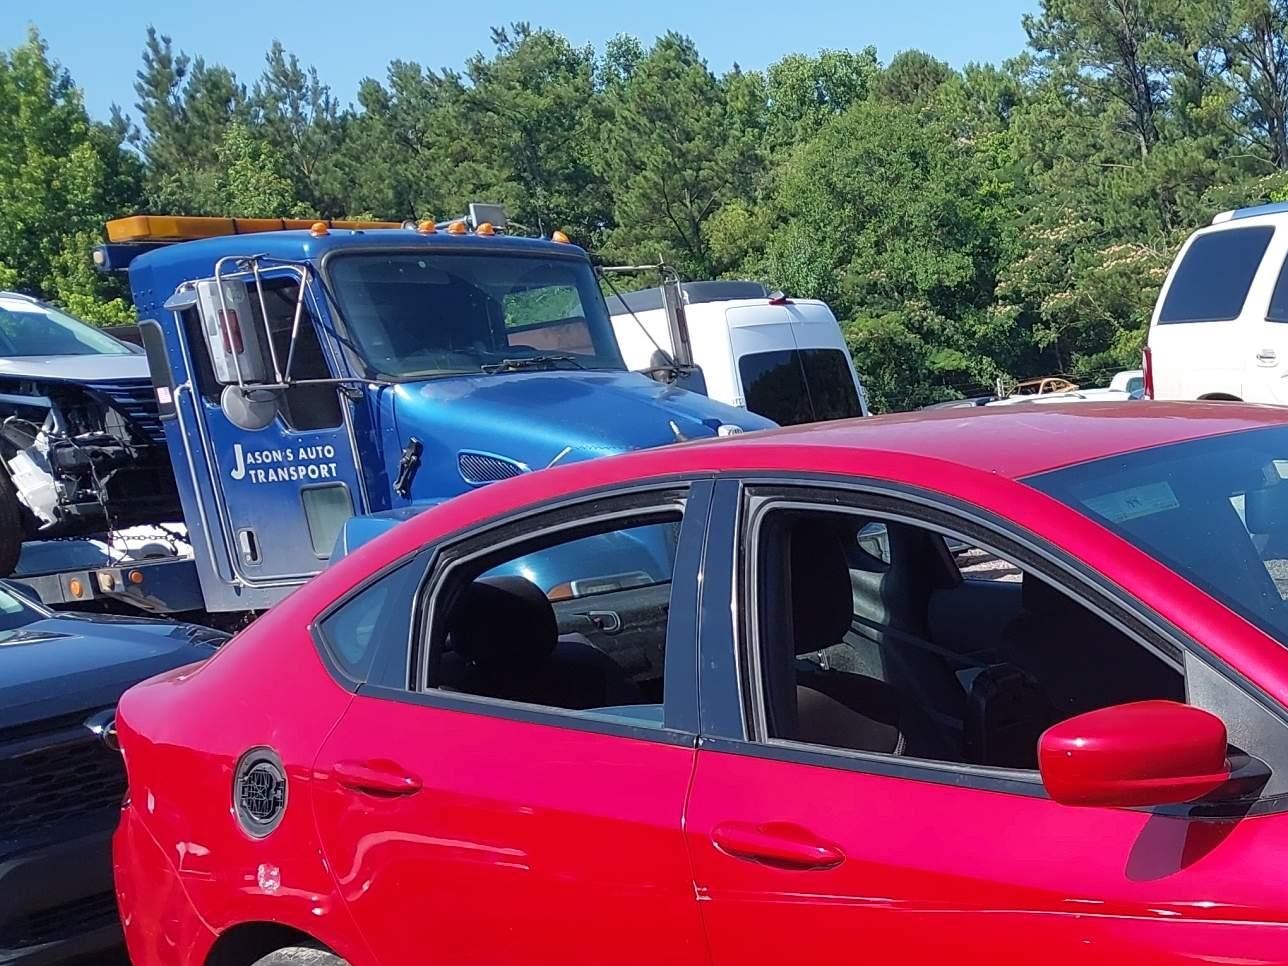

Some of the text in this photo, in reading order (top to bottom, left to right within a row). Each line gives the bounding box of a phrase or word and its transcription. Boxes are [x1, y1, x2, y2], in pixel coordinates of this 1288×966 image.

[231, 443, 335, 480] JASON'S AUTO
[248, 463, 337, 484] TRANSPORT
